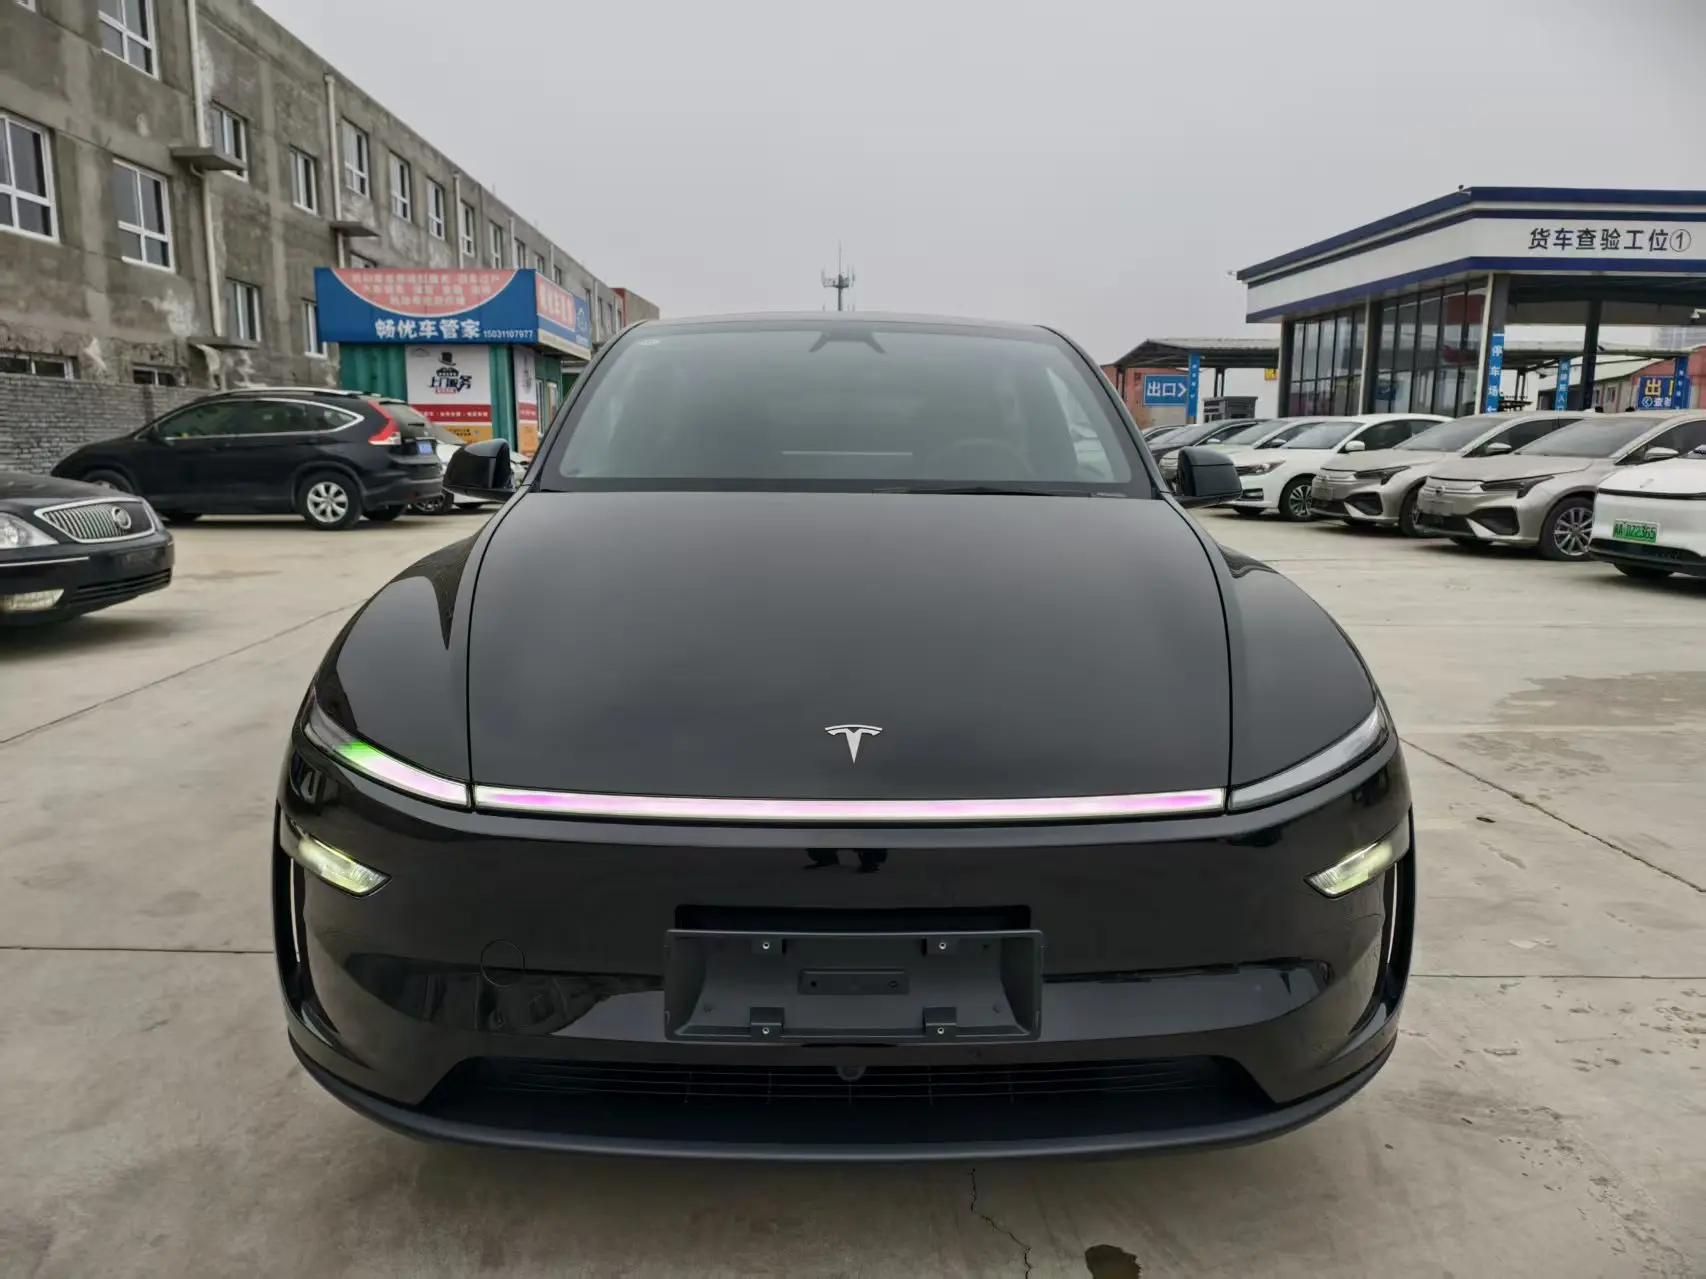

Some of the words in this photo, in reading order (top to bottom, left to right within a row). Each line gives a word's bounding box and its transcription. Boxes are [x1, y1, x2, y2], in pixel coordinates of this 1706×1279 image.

[1528, 227, 1692, 252] 货车查验工位①
[375, 318, 481, 339] 畅优车管家
[1488, 345, 1503, 397] 停车场
[1147, 381, 1176, 397] 出口
[1645, 378, 1674, 397] 出
